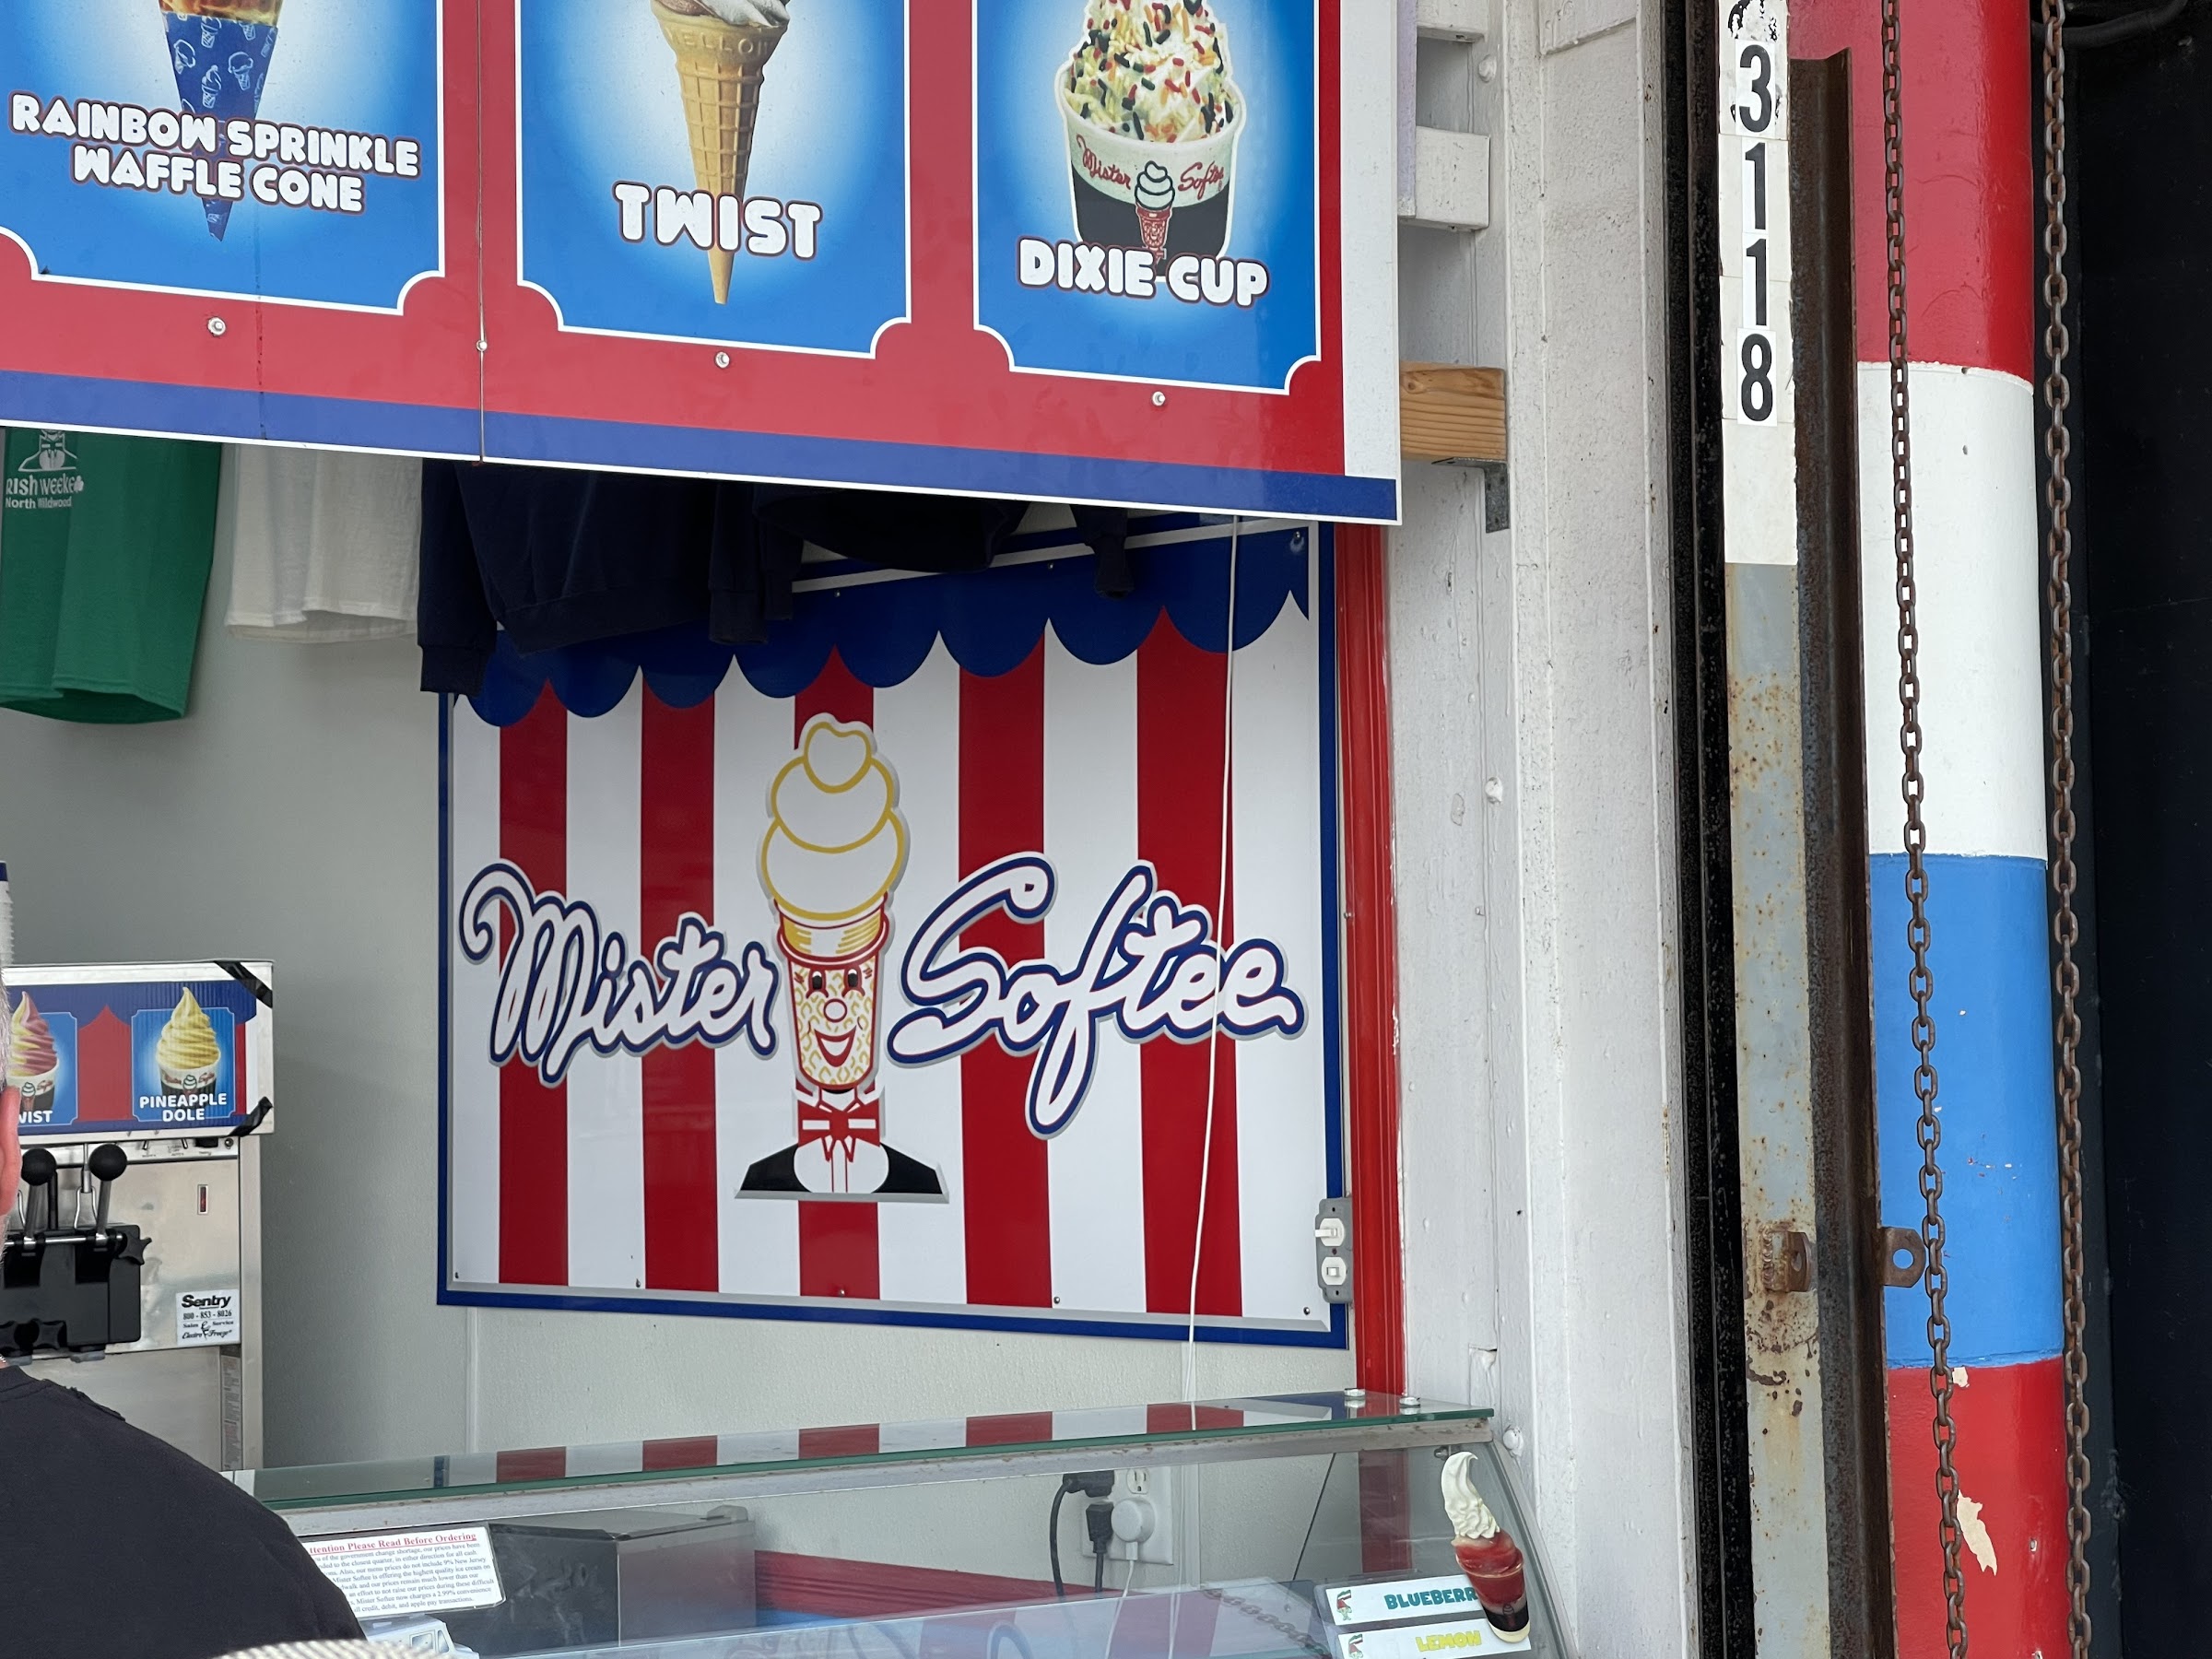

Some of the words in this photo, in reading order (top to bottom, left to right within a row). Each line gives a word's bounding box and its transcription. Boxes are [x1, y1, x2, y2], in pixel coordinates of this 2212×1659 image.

[10, 92, 218, 151] RAINBOW
[226, 120, 421, 179] SPRINKLE
[1076, 134, 1131, 190] Mister
[73, 144, 243, 200] WAFFLE
[250, 170, 365, 214] CONE
[613, 182, 823, 260] TWIST
[1018, 237, 1156, 299] DIXIE
[1166, 255, 1269, 309] CUP
[6, 496, 36, 509] North
[458, 859, 780, 1086] Mister
[887, 853, 1305, 1137] Softee
[139, 1092, 228, 1109] PINEAPPLE
[18, 1110, 53, 1124] WIST
[161, 1108, 206, 1123] DOLE
[181, 1294, 231, 1308] Sentry
[310, 1545, 345, 1554] ttention
[347, 1542, 375, 1550] Please
[378, 1539, 401, 1547] Read
[404, 1536, 433, 1546] Before
[435, 1533, 477, 1544] Ordering
[340, 1552, 374, 1561] government
[375, 1549, 395, 1558] change
[434, 1545, 452, 1553] prices
[384, 1564, 402, 1572] prices
[469, 1557, 486, 1565] Jersey
[379, 1572, 402, 1581] offering
[413, 1569, 434, 1578] highest
[435, 1567, 453, 1575] quality
[382, 1580, 399, 1588] prices
[418, 1584, 435, 1593] prices
[437, 1583, 455, 1591] during
[409, 1593, 431, 1601] charges
[1383, 1587, 1479, 1610] BLUEBERR
[1415, 1630, 1482, 1653] LEMON
